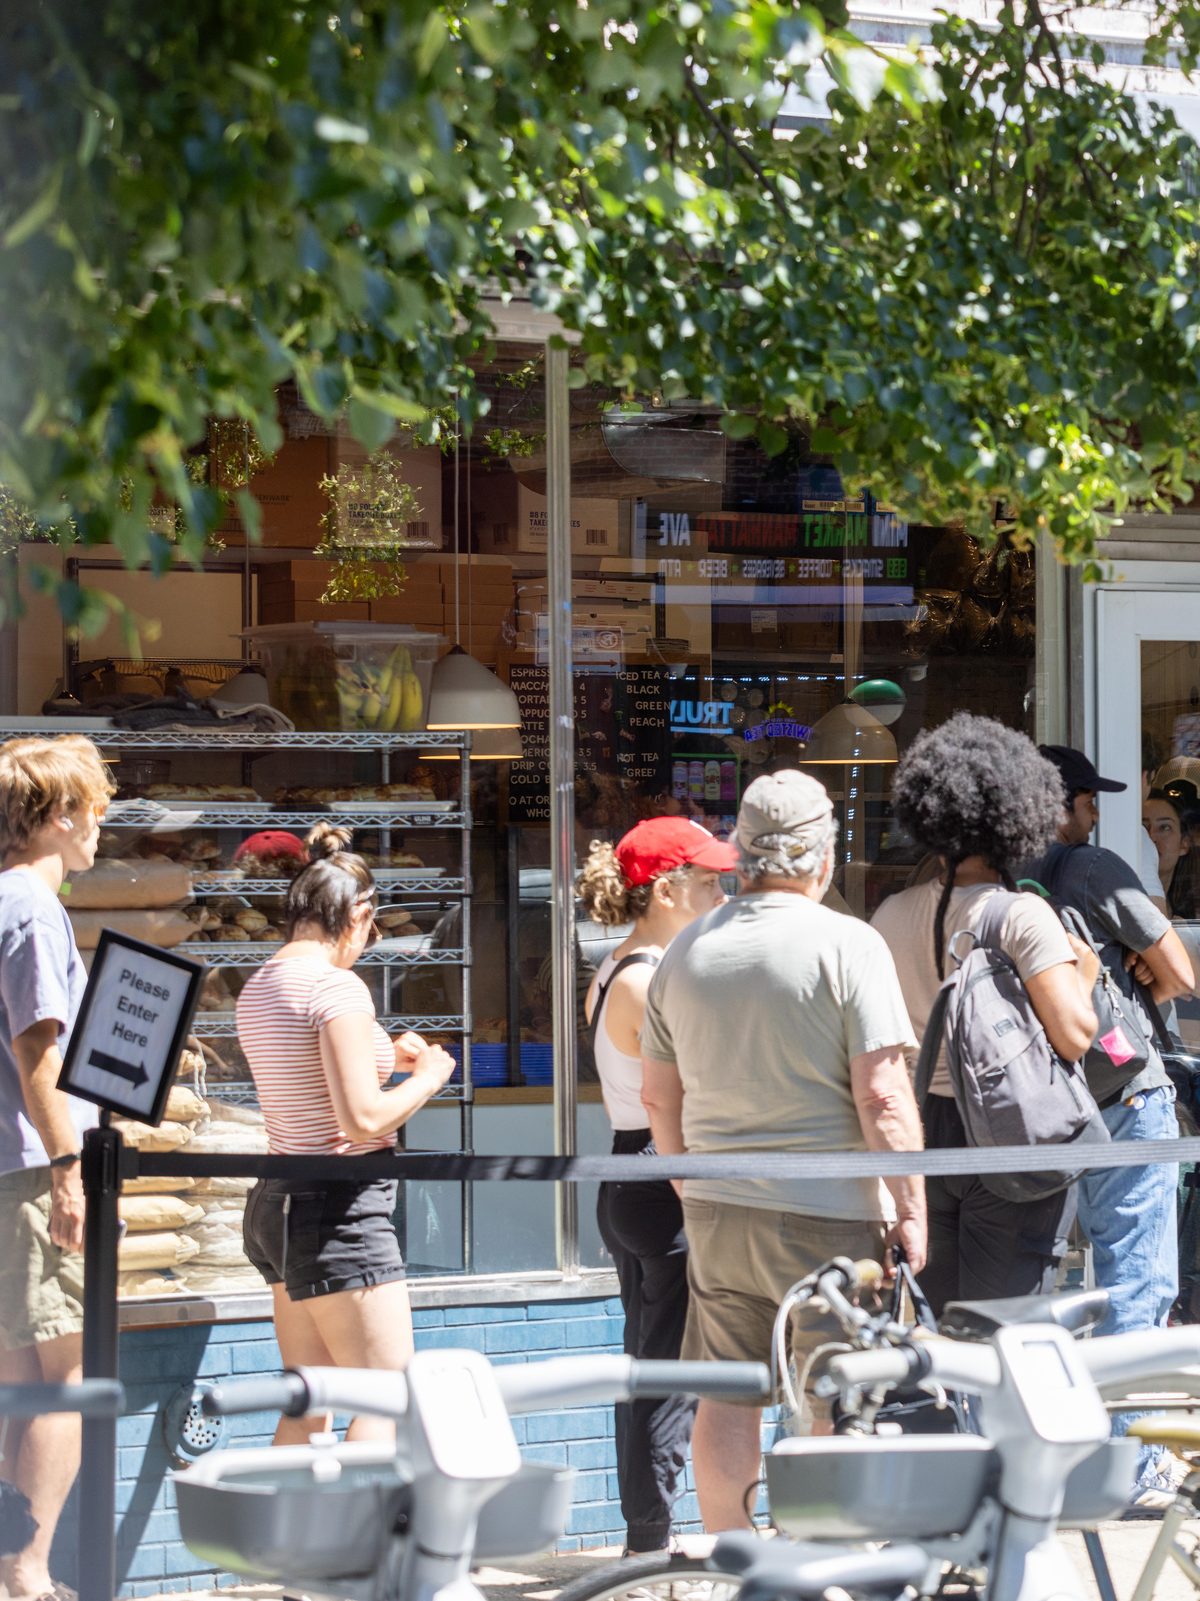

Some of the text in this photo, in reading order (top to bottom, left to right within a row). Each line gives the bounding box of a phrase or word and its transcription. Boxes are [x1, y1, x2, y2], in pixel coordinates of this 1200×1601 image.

[511, 667, 551, 678] ESPRESS
[615, 670, 640, 681] ICED
[640, 670, 661, 680] TEA
[625, 684, 661, 695] BLACK
[635, 700, 671, 711] GREEN
[519, 721, 545, 731] ATTE
[629, 717, 665, 728] PEACH
[521, 734, 551, 744] OCHA
[616, 752, 659, 763] HOT TEA
[511, 760, 535, 771] DRIP
[510, 774, 541, 785] COLD
[526, 808, 551, 818] WHO
[118, 968, 171, 1002] Please
[115, 995, 160, 1025] Enter
[111, 1020, 149, 1049] Here
